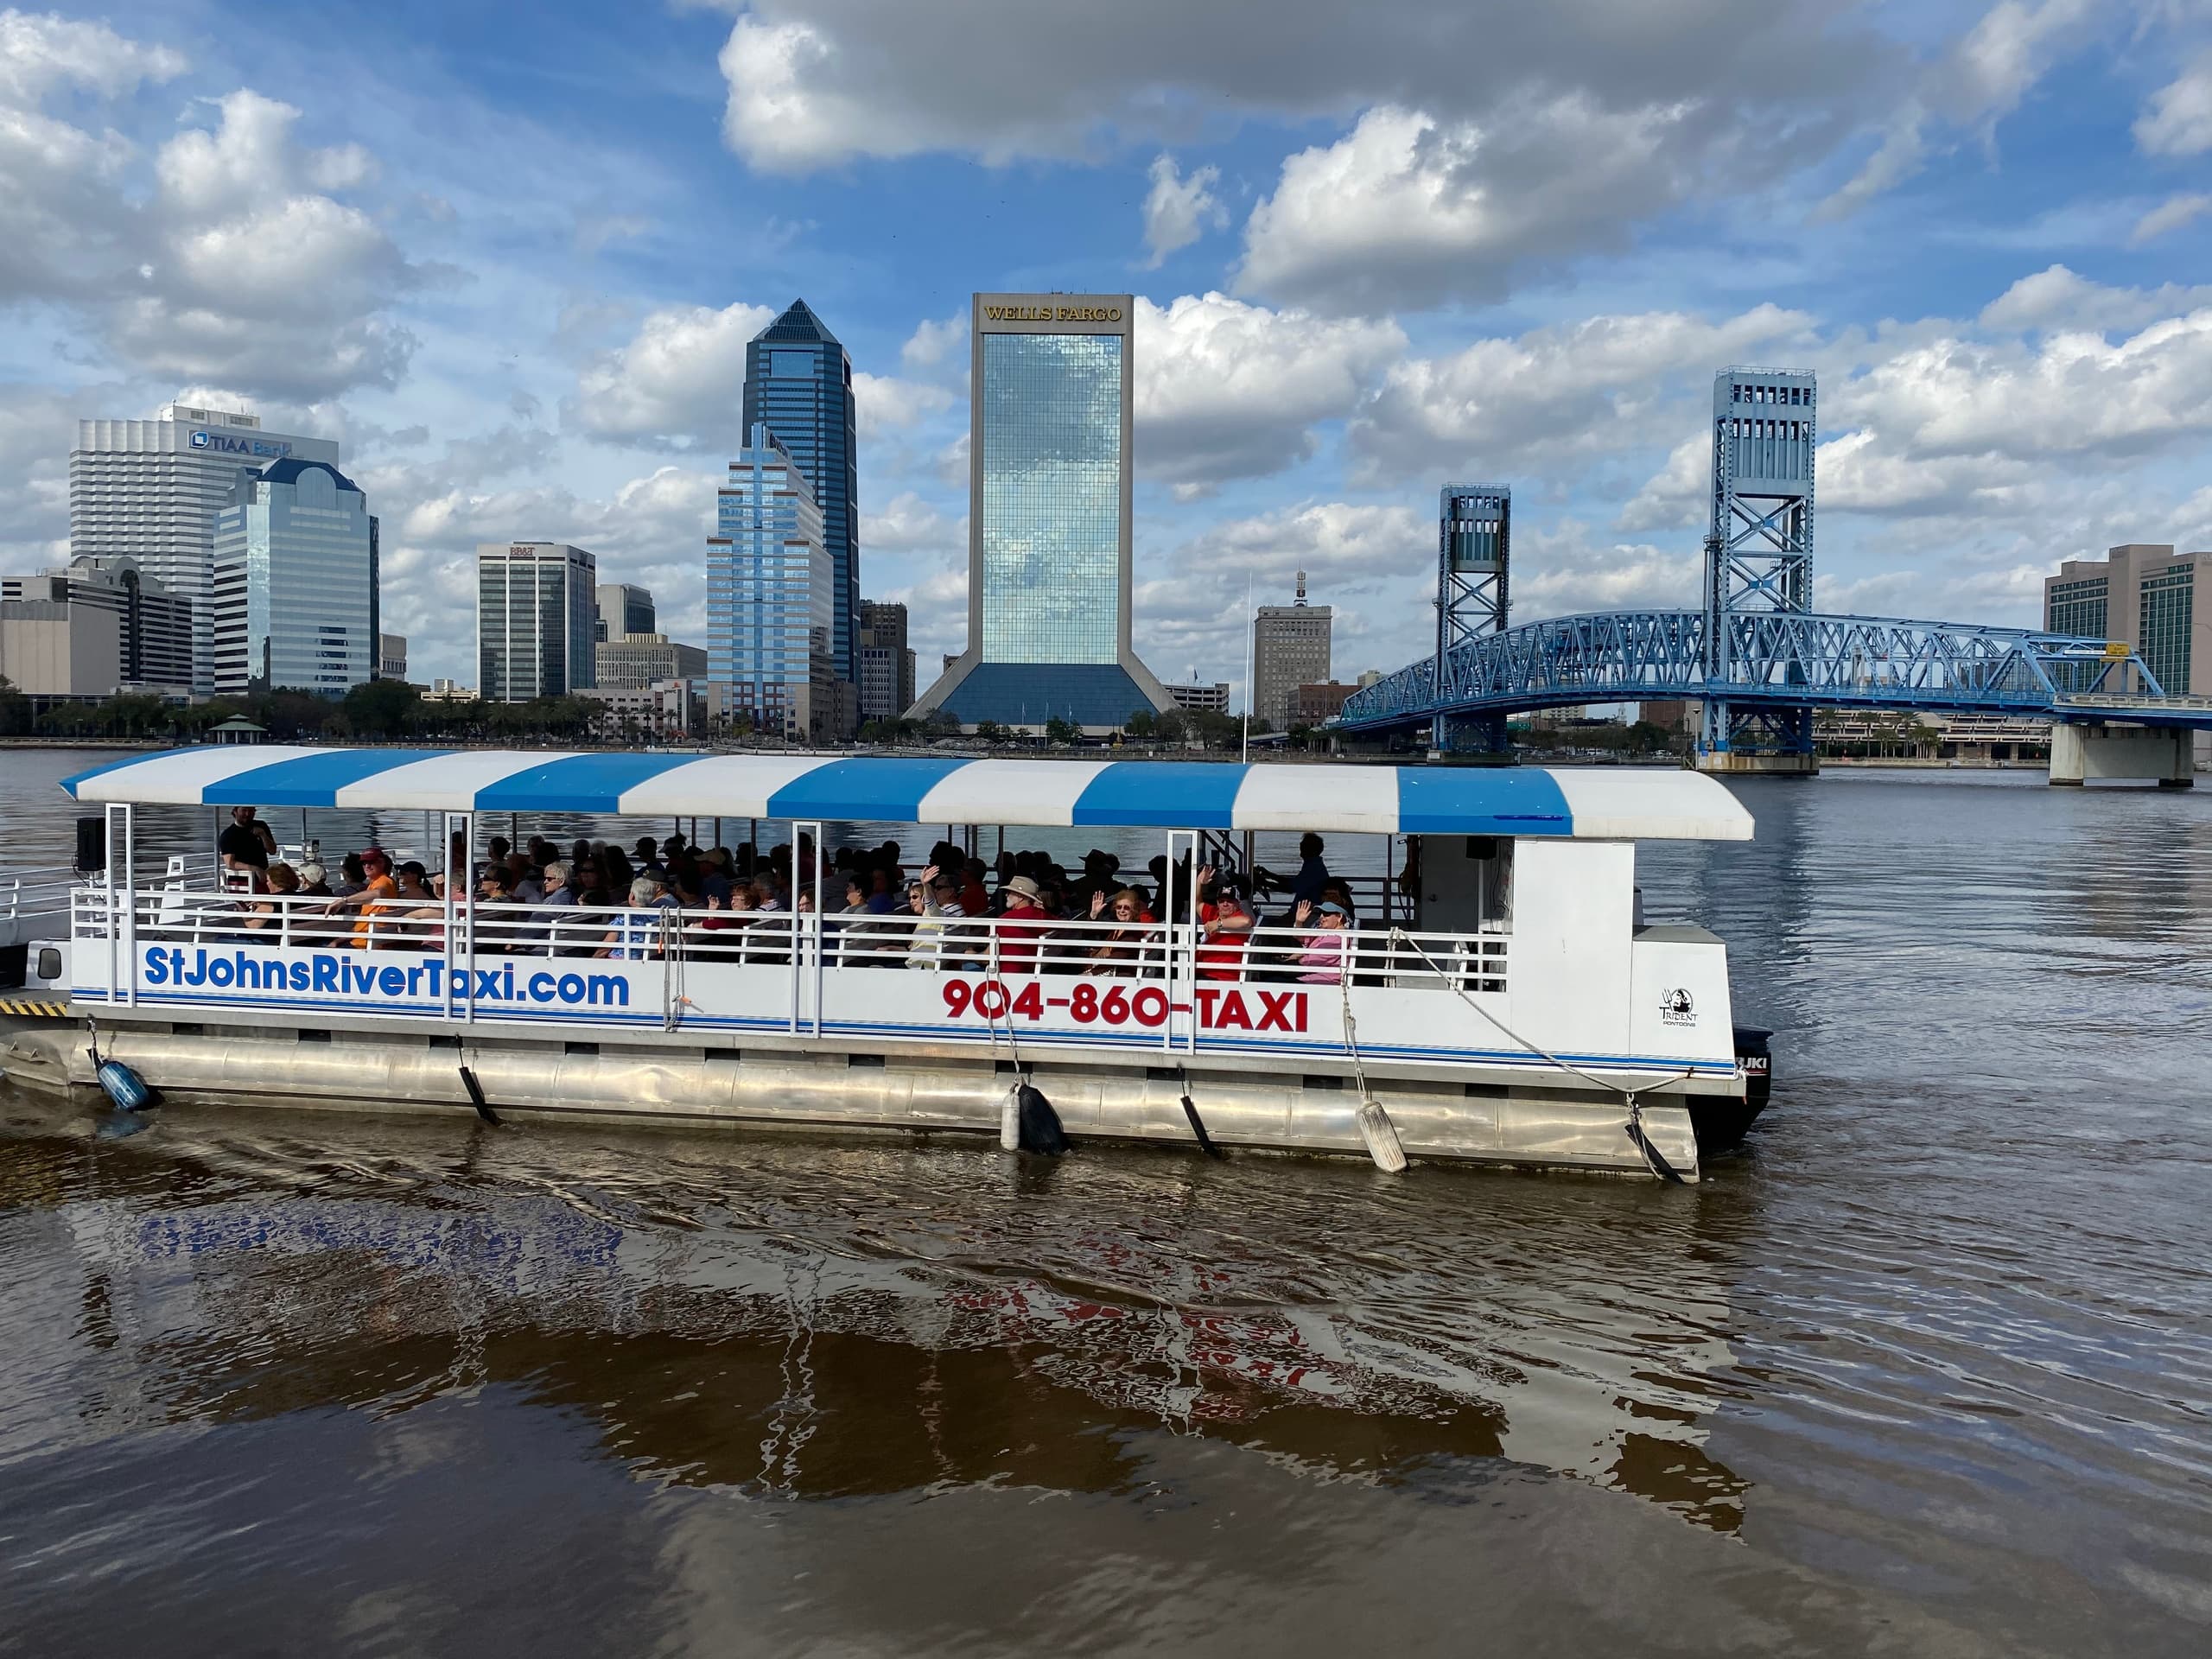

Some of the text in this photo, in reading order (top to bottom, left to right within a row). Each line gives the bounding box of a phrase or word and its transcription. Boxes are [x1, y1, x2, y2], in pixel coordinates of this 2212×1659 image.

[985, 306, 1122, 321] WELLS FARGO
[210, 435, 292, 458] TIAA Bank
[145, 947, 629, 1006] StJohnsRiverTaxi.com
[943, 979, 1308, 1033] 904-860-TAXI
